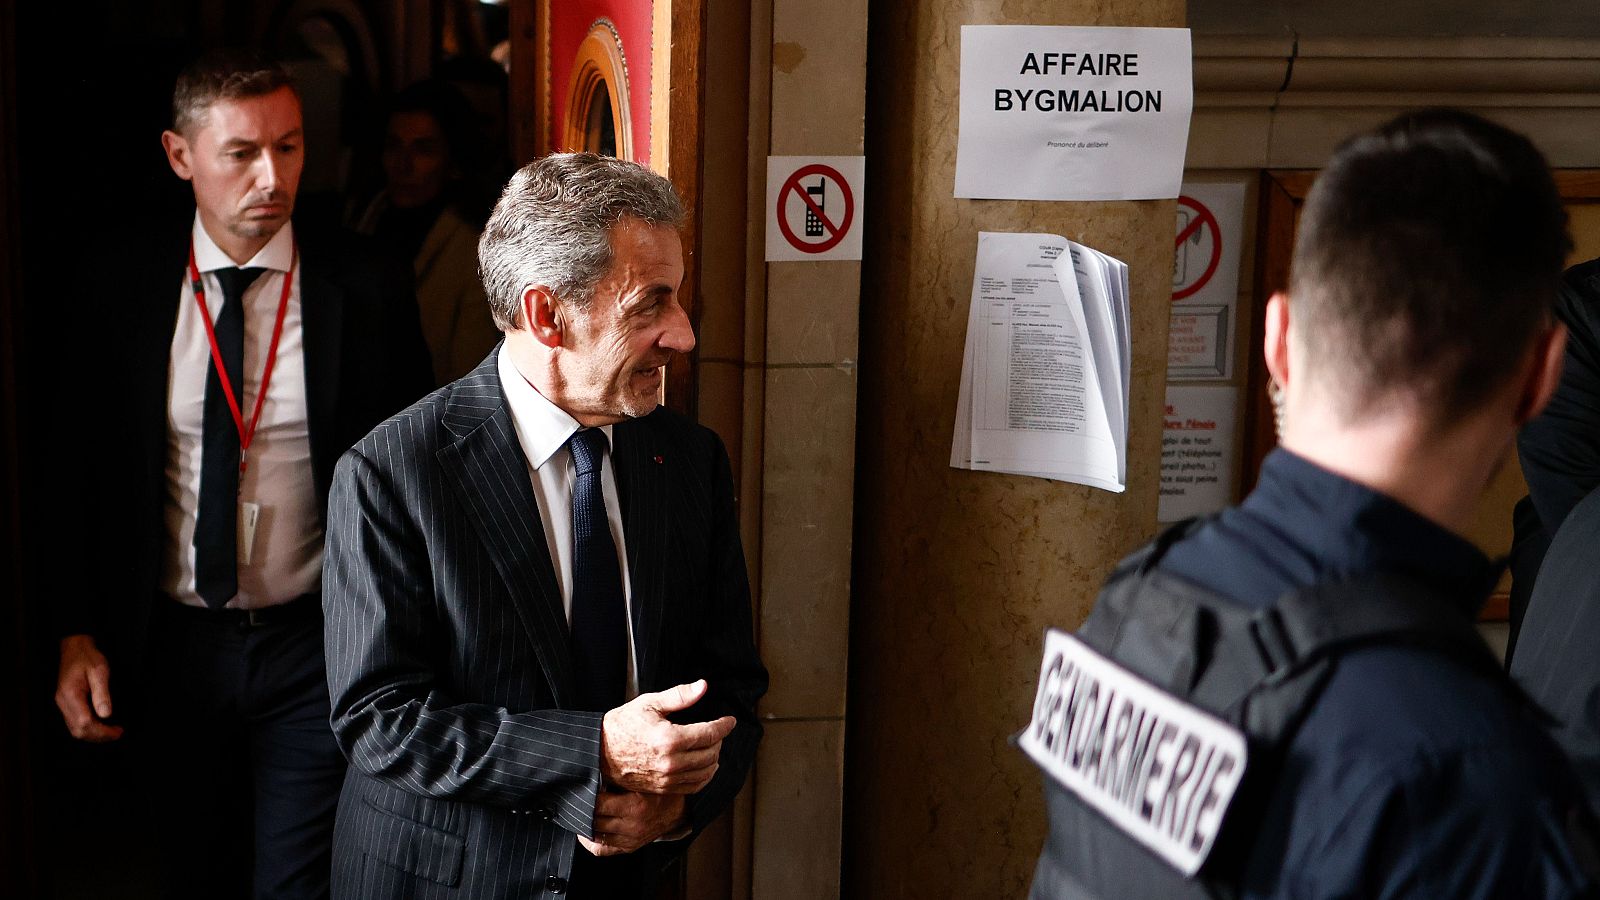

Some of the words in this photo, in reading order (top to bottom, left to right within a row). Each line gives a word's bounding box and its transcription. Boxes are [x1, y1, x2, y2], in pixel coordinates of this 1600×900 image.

[1020, 53, 1138, 76] AFFAIRE
[994, 89, 1162, 113] BYGMALION
[1077, 141, 1085, 149] du
[1180, 437, 1191, 445] de
[1194, 437, 1212, 445] tout
[1034, 652, 1237, 851] GENDARMERIE
